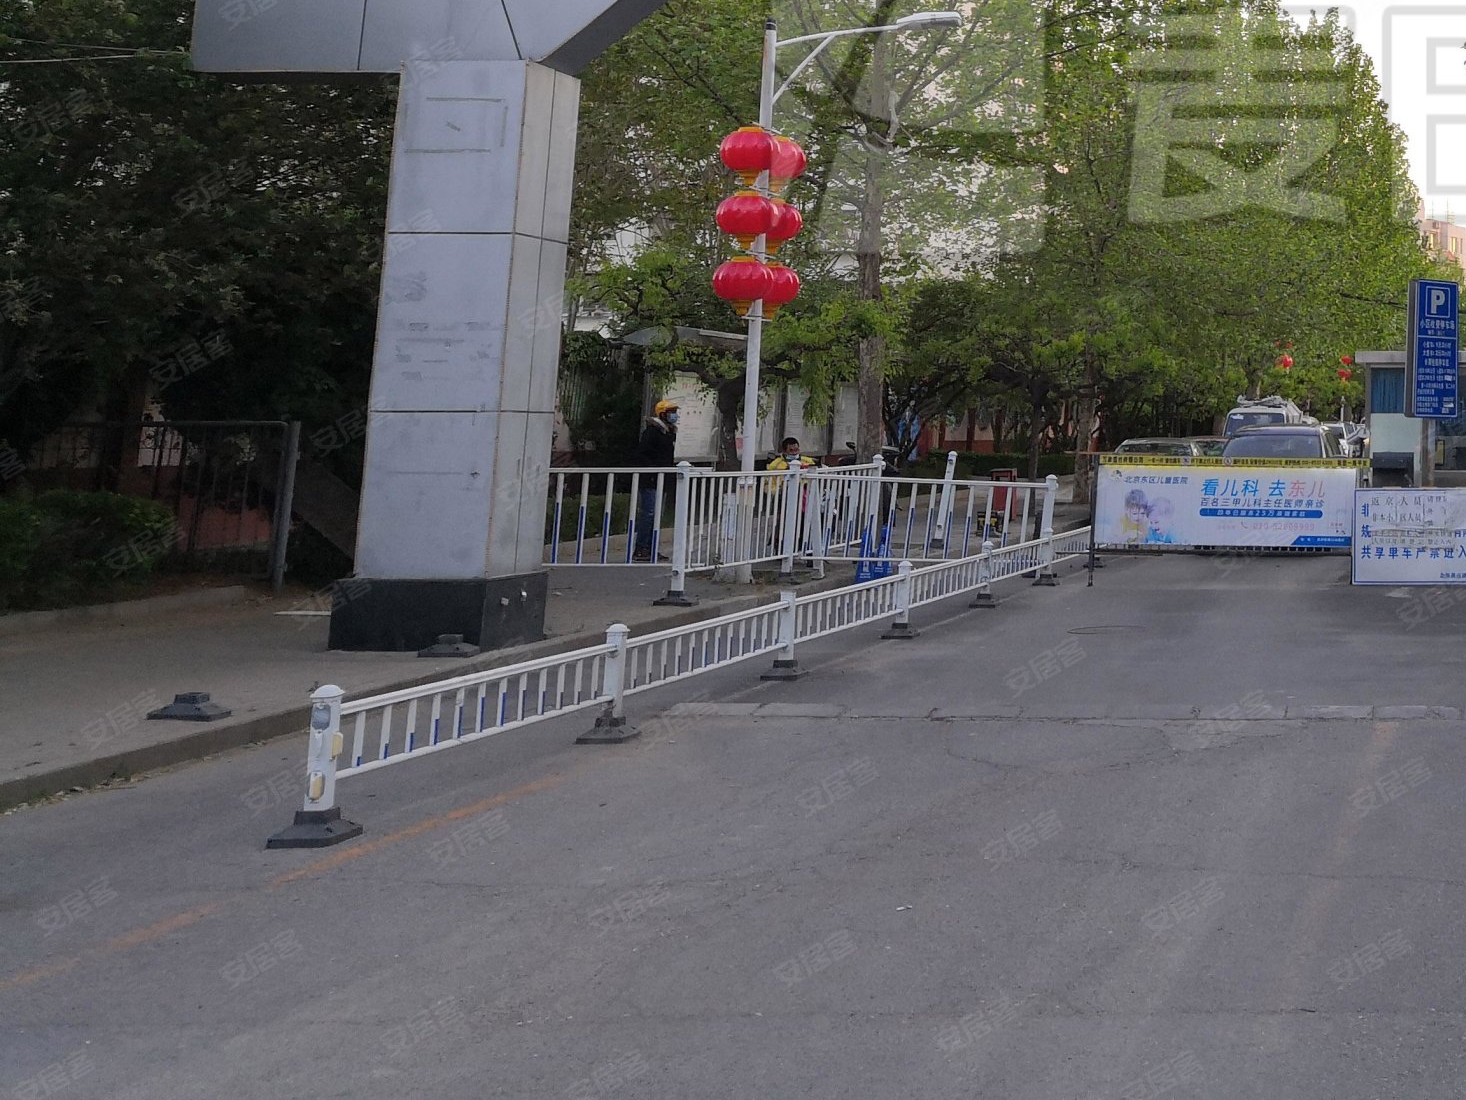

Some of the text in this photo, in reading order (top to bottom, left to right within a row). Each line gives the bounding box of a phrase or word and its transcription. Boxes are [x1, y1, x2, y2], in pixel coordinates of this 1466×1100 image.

[1430, 290, 1446, 314] P
[1124, 476, 1188, 485] 北京东区儿童医院
[1201, 478, 1326, 498] 看儿科 去东儿
[1371, 496, 1422, 506] 返京人员
